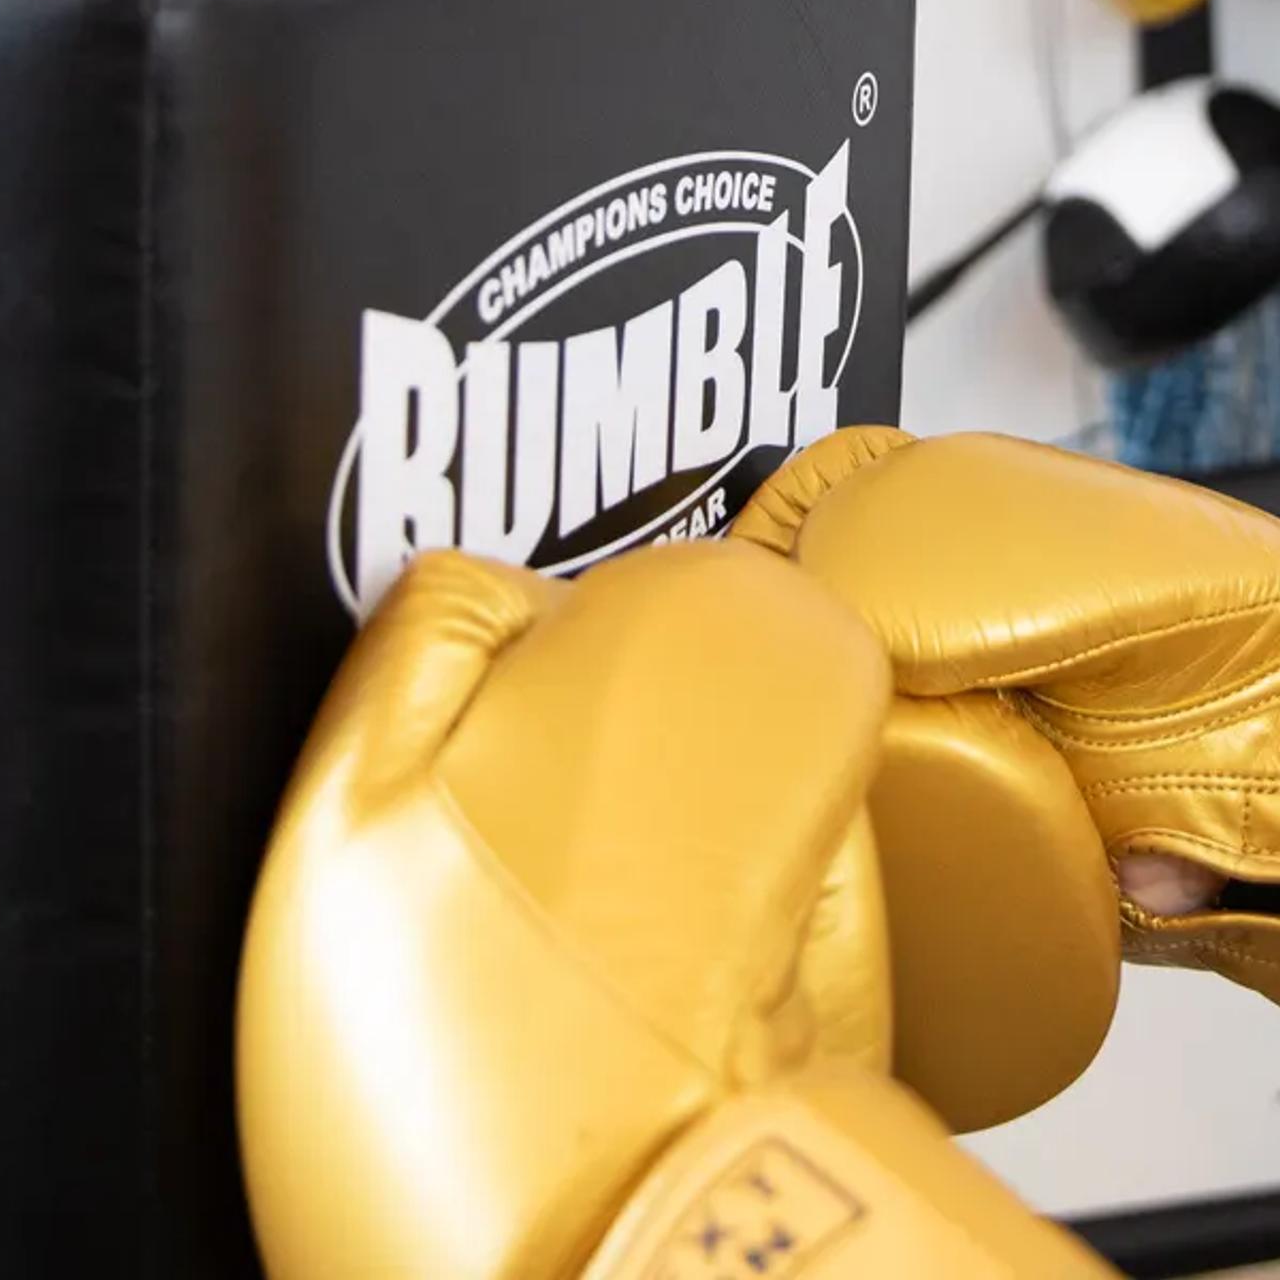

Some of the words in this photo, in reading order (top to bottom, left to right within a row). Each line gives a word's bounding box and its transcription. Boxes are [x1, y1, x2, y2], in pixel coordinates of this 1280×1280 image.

[357, 137, 850, 630] RUMBLE
[477, 182, 668, 324] CHAMPIONS
[674, 170, 777, 216] CHOICE
